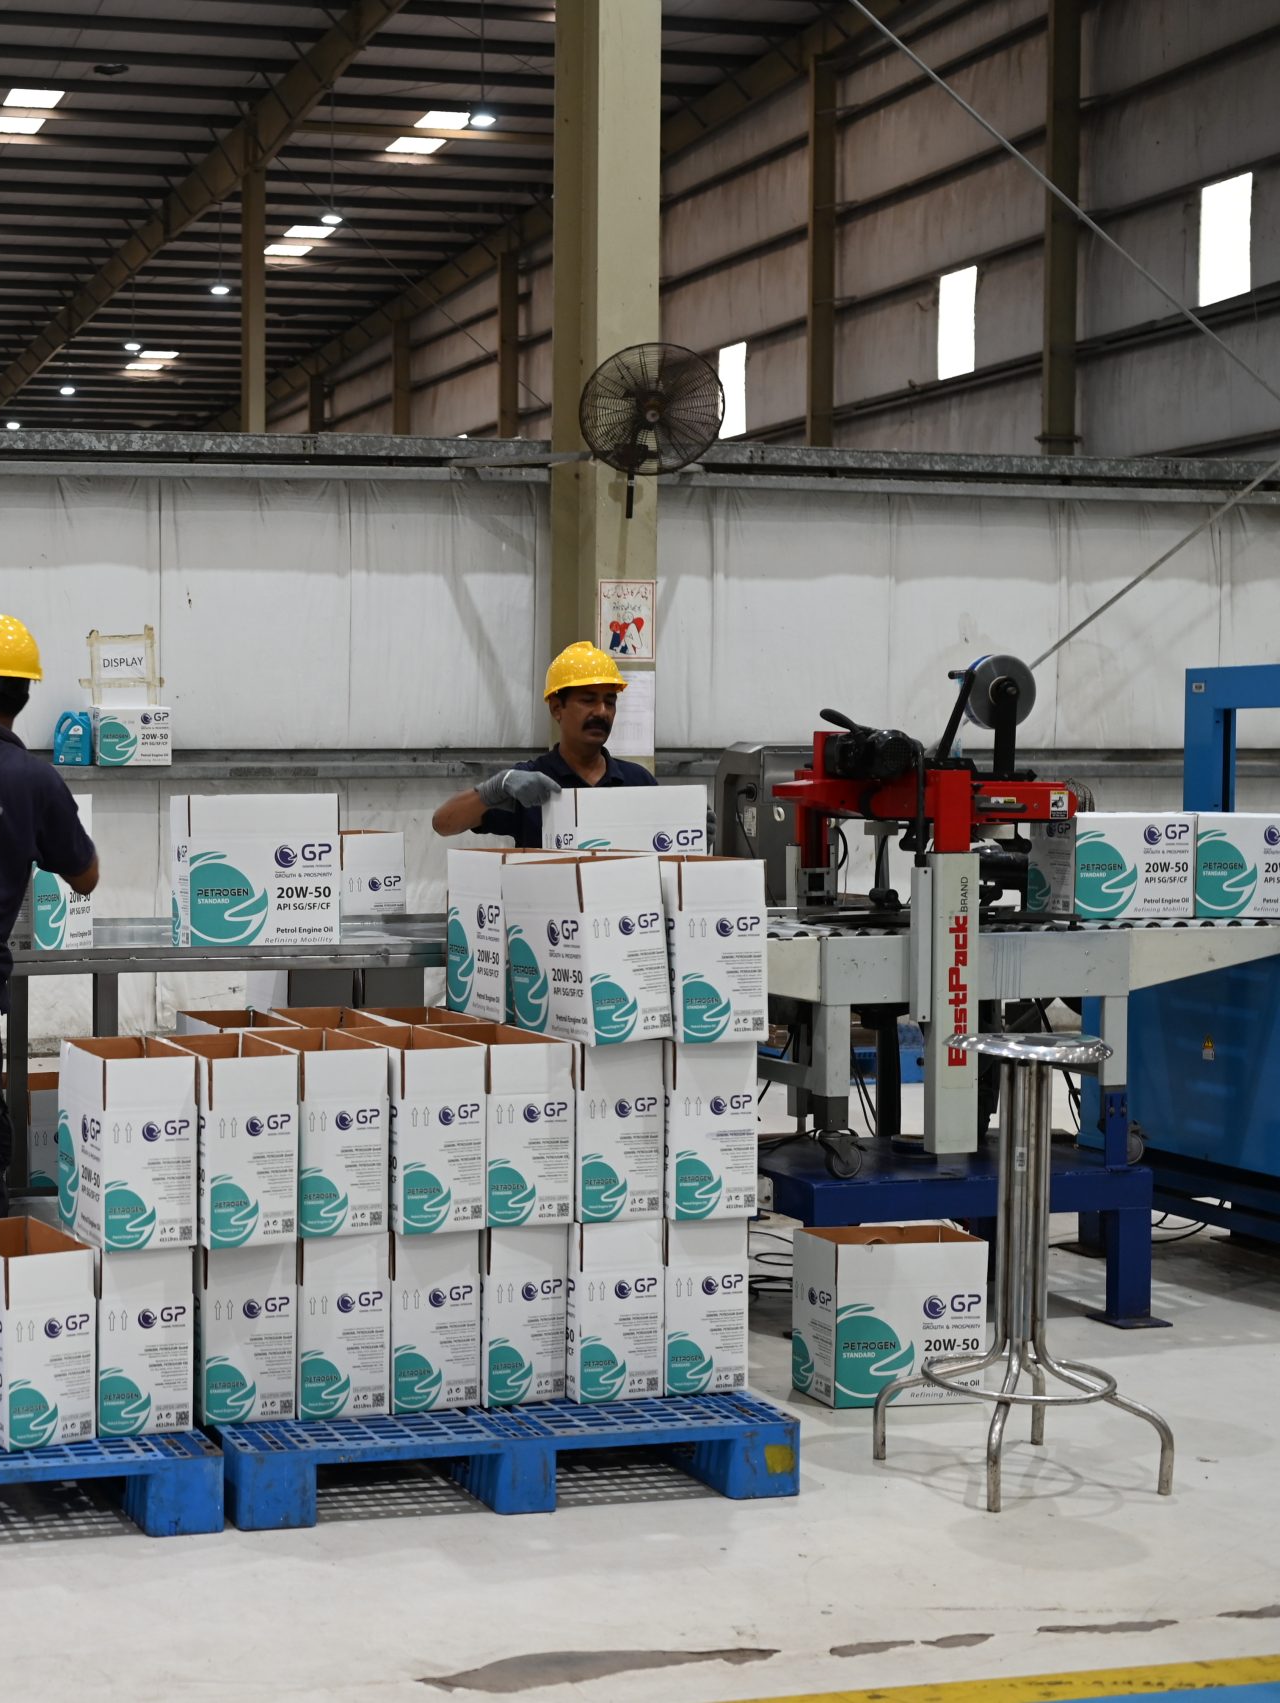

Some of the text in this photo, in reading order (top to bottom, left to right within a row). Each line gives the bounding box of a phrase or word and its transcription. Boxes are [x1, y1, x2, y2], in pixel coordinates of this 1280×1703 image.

[103, 657, 143, 667] DISPLAY
[154, 713, 169, 721] GP
[1057, 823, 1070, 834] GP
[1165, 825, 1189, 839] GP
[563, 833, 573, 846] GP
[676, 830, 703, 845] GP
[301, 844, 332, 861] GP
[1145, 862, 1188, 872] 20W-50
[384, 876, 401, 887] GP
[277, 886, 331, 899] 20W-50
[487, 905, 500, 925] GP
[638, 913, 659, 929] GP
[298, 927, 324, 935] Engine
[561, 919, 579, 940] GP
[737, 917, 760, 931] GP
[477, 949, 499, 965] 20W-50
[512, 964, 538, 976] PETROGEN
[552, 968, 583, 984] 20W-50
[553, 986, 584, 998] API SG/SF/CF
[556, 1014, 568, 1023] Petrol
[569, 1015, 581, 1026] Engine
[544, 1102, 567, 1117] GP
[635, 1097, 657, 1112] GP
[730, 1095, 752, 1109] GP
[357, 1109, 380, 1124] GP
[458, 1104, 480, 1118] GP
[90, 1119, 101, 1140] GP
[165, 1120, 190, 1135] GP
[267, 1114, 291, 1130] GP
[82, 1165, 100, 1188] 20W-50
[541, 1279, 562, 1294] GP
[635, 1278, 657, 1292] GP
[722, 1274, 743, 1289] GP
[359, 1291, 383, 1307] GP
[450, 1285, 473, 1300] GP
[819, 1291, 831, 1305] GP
[265, 1297, 290, 1312] GP
[951, 1294, 981, 1312] GP
[161, 1306, 186, 1322] GP
[66, 1314, 89, 1331] GP
[843, 1342, 896, 1350] PETROGEN
[924, 1338, 979, 1352] 20W-50
